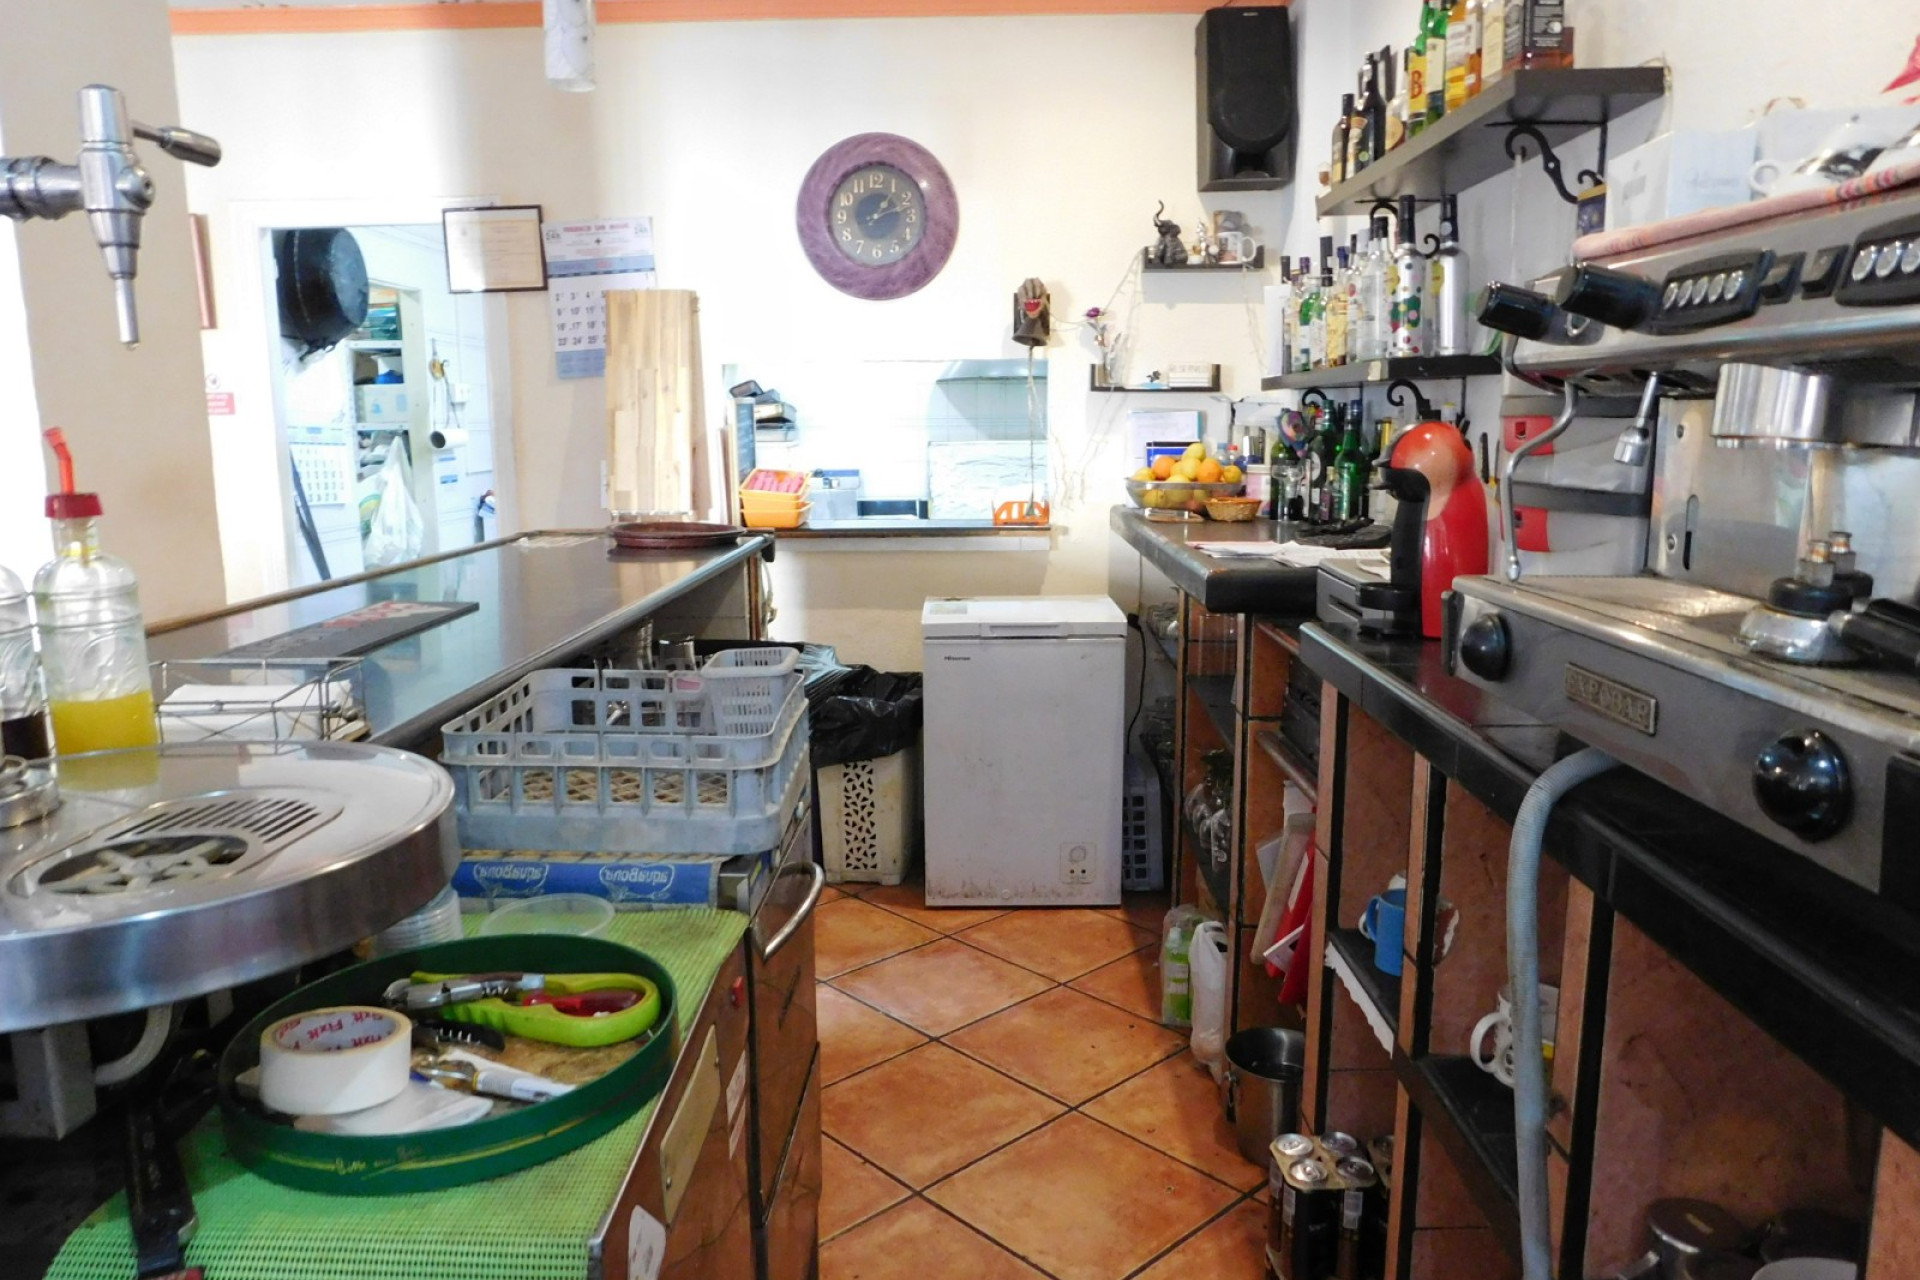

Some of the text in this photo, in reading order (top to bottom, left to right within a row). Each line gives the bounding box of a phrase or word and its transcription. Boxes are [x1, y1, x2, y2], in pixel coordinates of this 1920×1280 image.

[1410, 70, 1423, 99] B
[853, 178, 865, 194] 11
[868, 173, 884, 189] 12
[890, 178, 896, 192] 1
[839, 193, 854, 207] 10
[901, 190, 912, 206] 2
[836, 211, 847, 225] 9
[905, 209, 916, 223] 3
[842, 228, 853, 241] 8
[855, 240, 865, 255] 7
[872, 243, 882, 259] 6
[889, 240, 901, 254] 5
